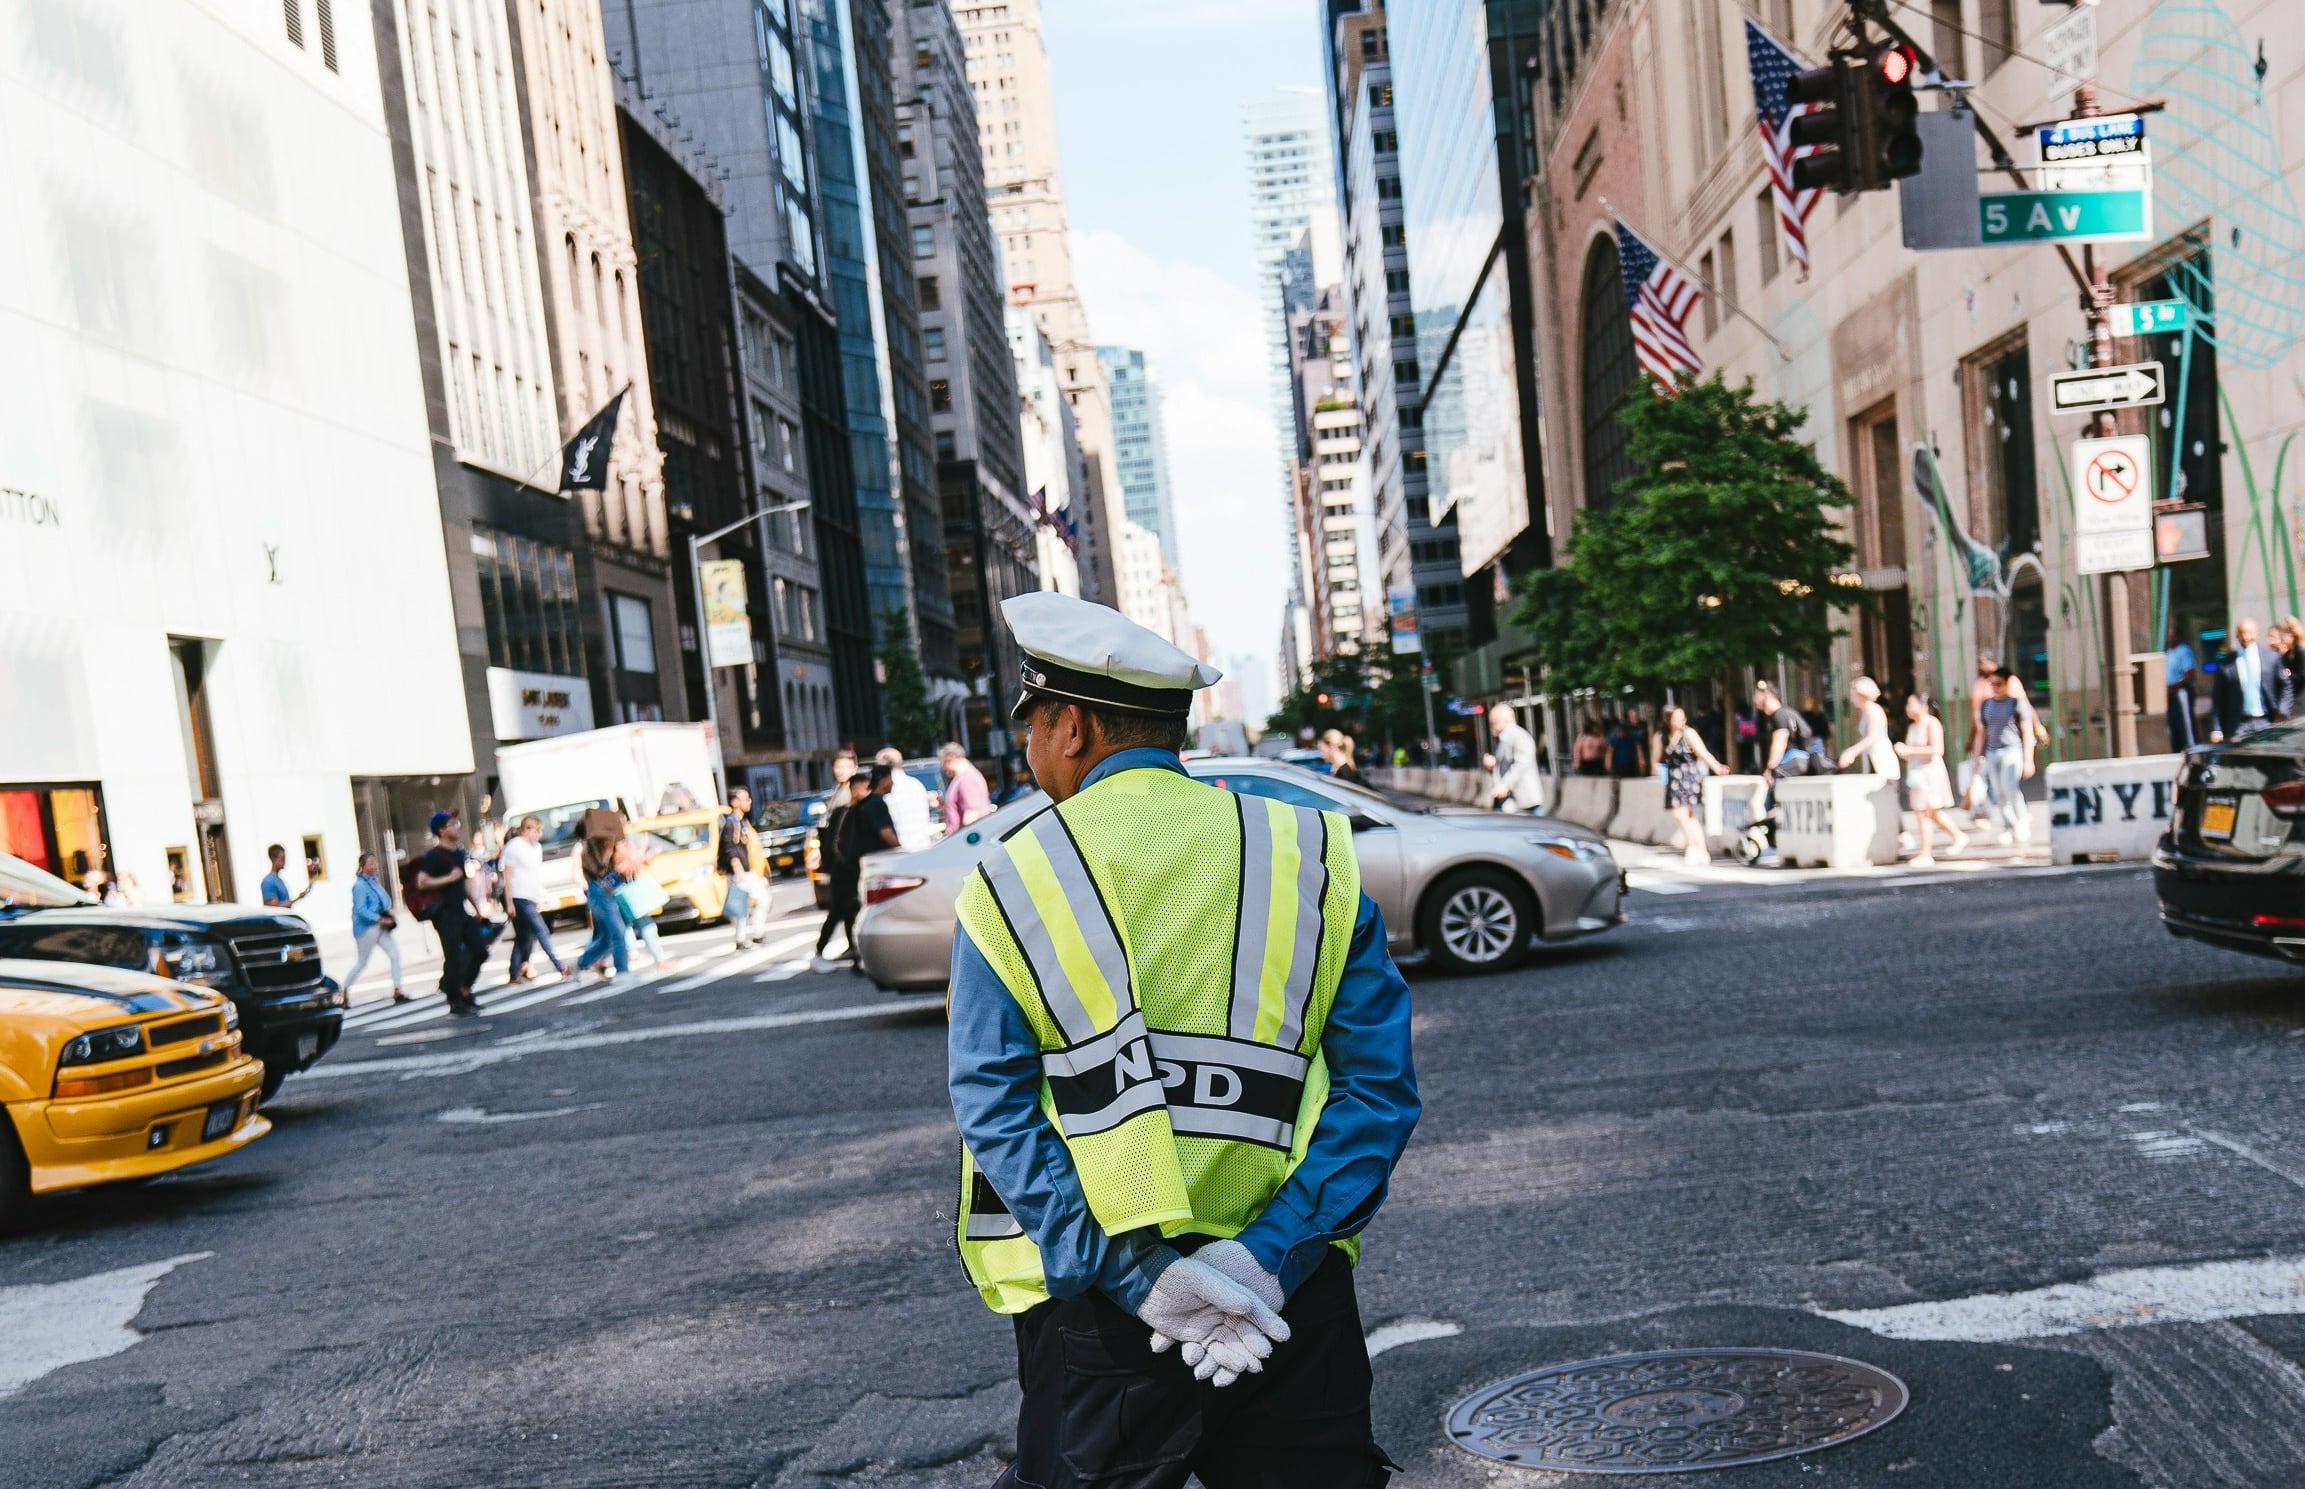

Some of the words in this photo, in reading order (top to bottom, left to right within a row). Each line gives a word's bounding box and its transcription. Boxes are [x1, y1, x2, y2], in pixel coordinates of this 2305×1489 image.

[2098, 135, 2138, 154] ONLY
[1986, 204, 2008, 234] 5
[2139, 306, 2155, 331] 5
[2074, 780, 2173, 826] NYP
